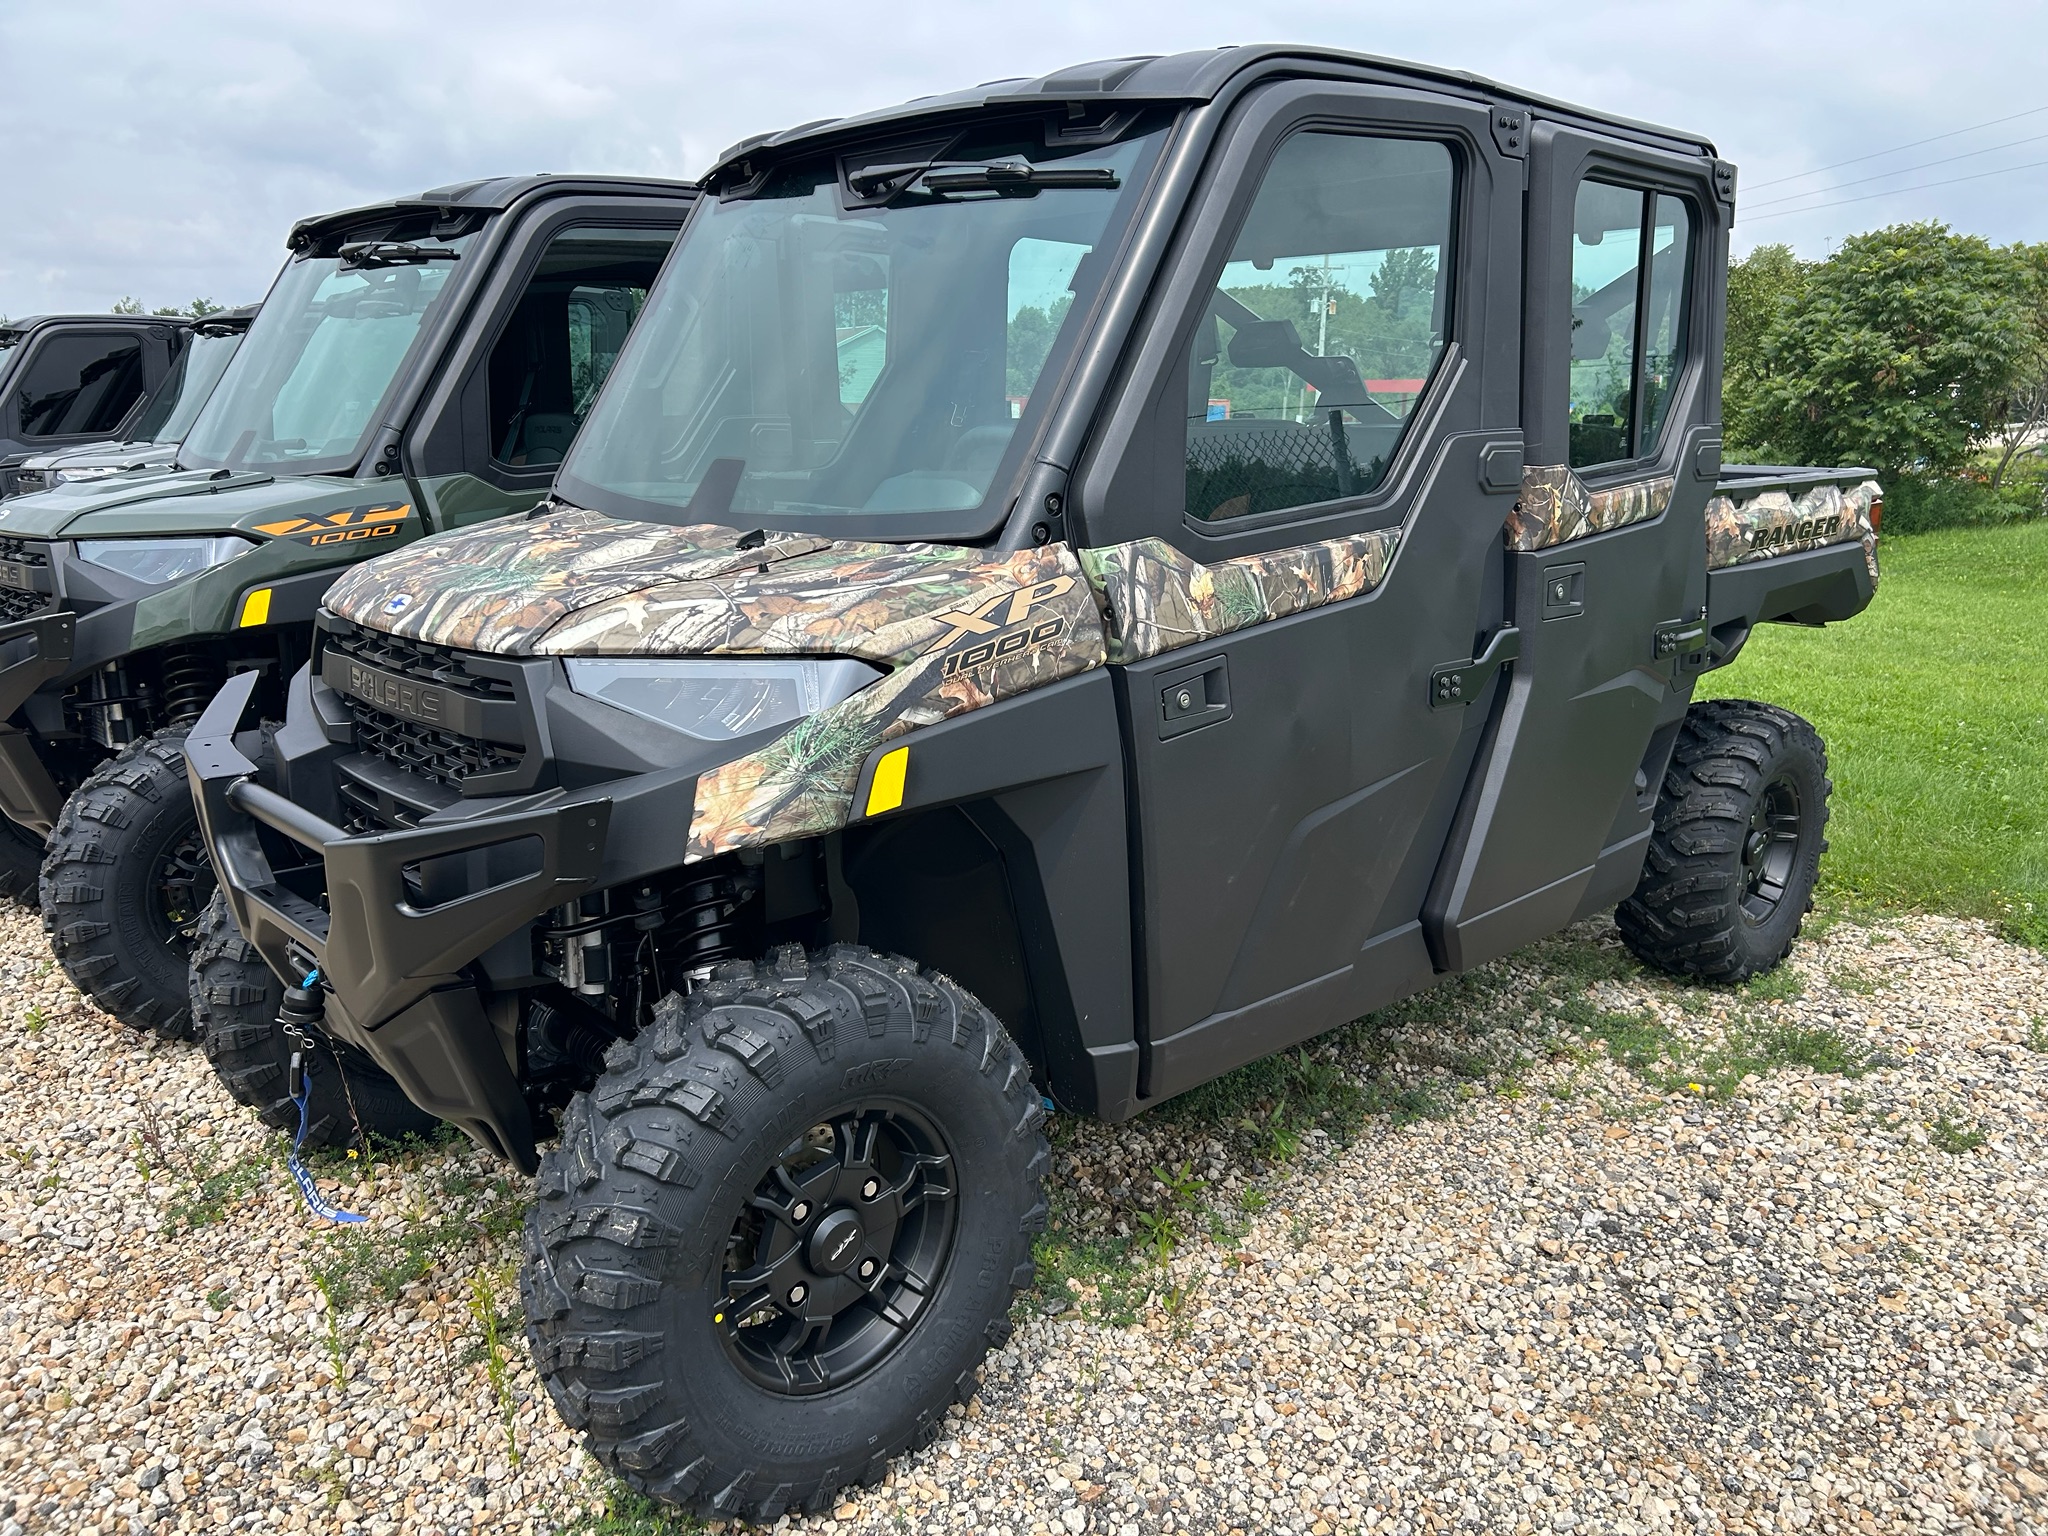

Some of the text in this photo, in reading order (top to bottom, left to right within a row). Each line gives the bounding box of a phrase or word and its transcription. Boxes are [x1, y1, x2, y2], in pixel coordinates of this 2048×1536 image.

[282, 500, 407, 534] XP
[310, 524, 398, 546] 1000
[1748, 514, 1841, 553] RANGER
[921, 574, 1078, 656] XP
[943, 616, 1066, 679] 1000
[944, 638, 1064, 687] DUAL OVERHEAD CAM
[350, 665, 441, 722] POLARIS
[290, 1158, 338, 1218] OLARIS
[921, 1236, 1007, 1382] PRO ARMOR
